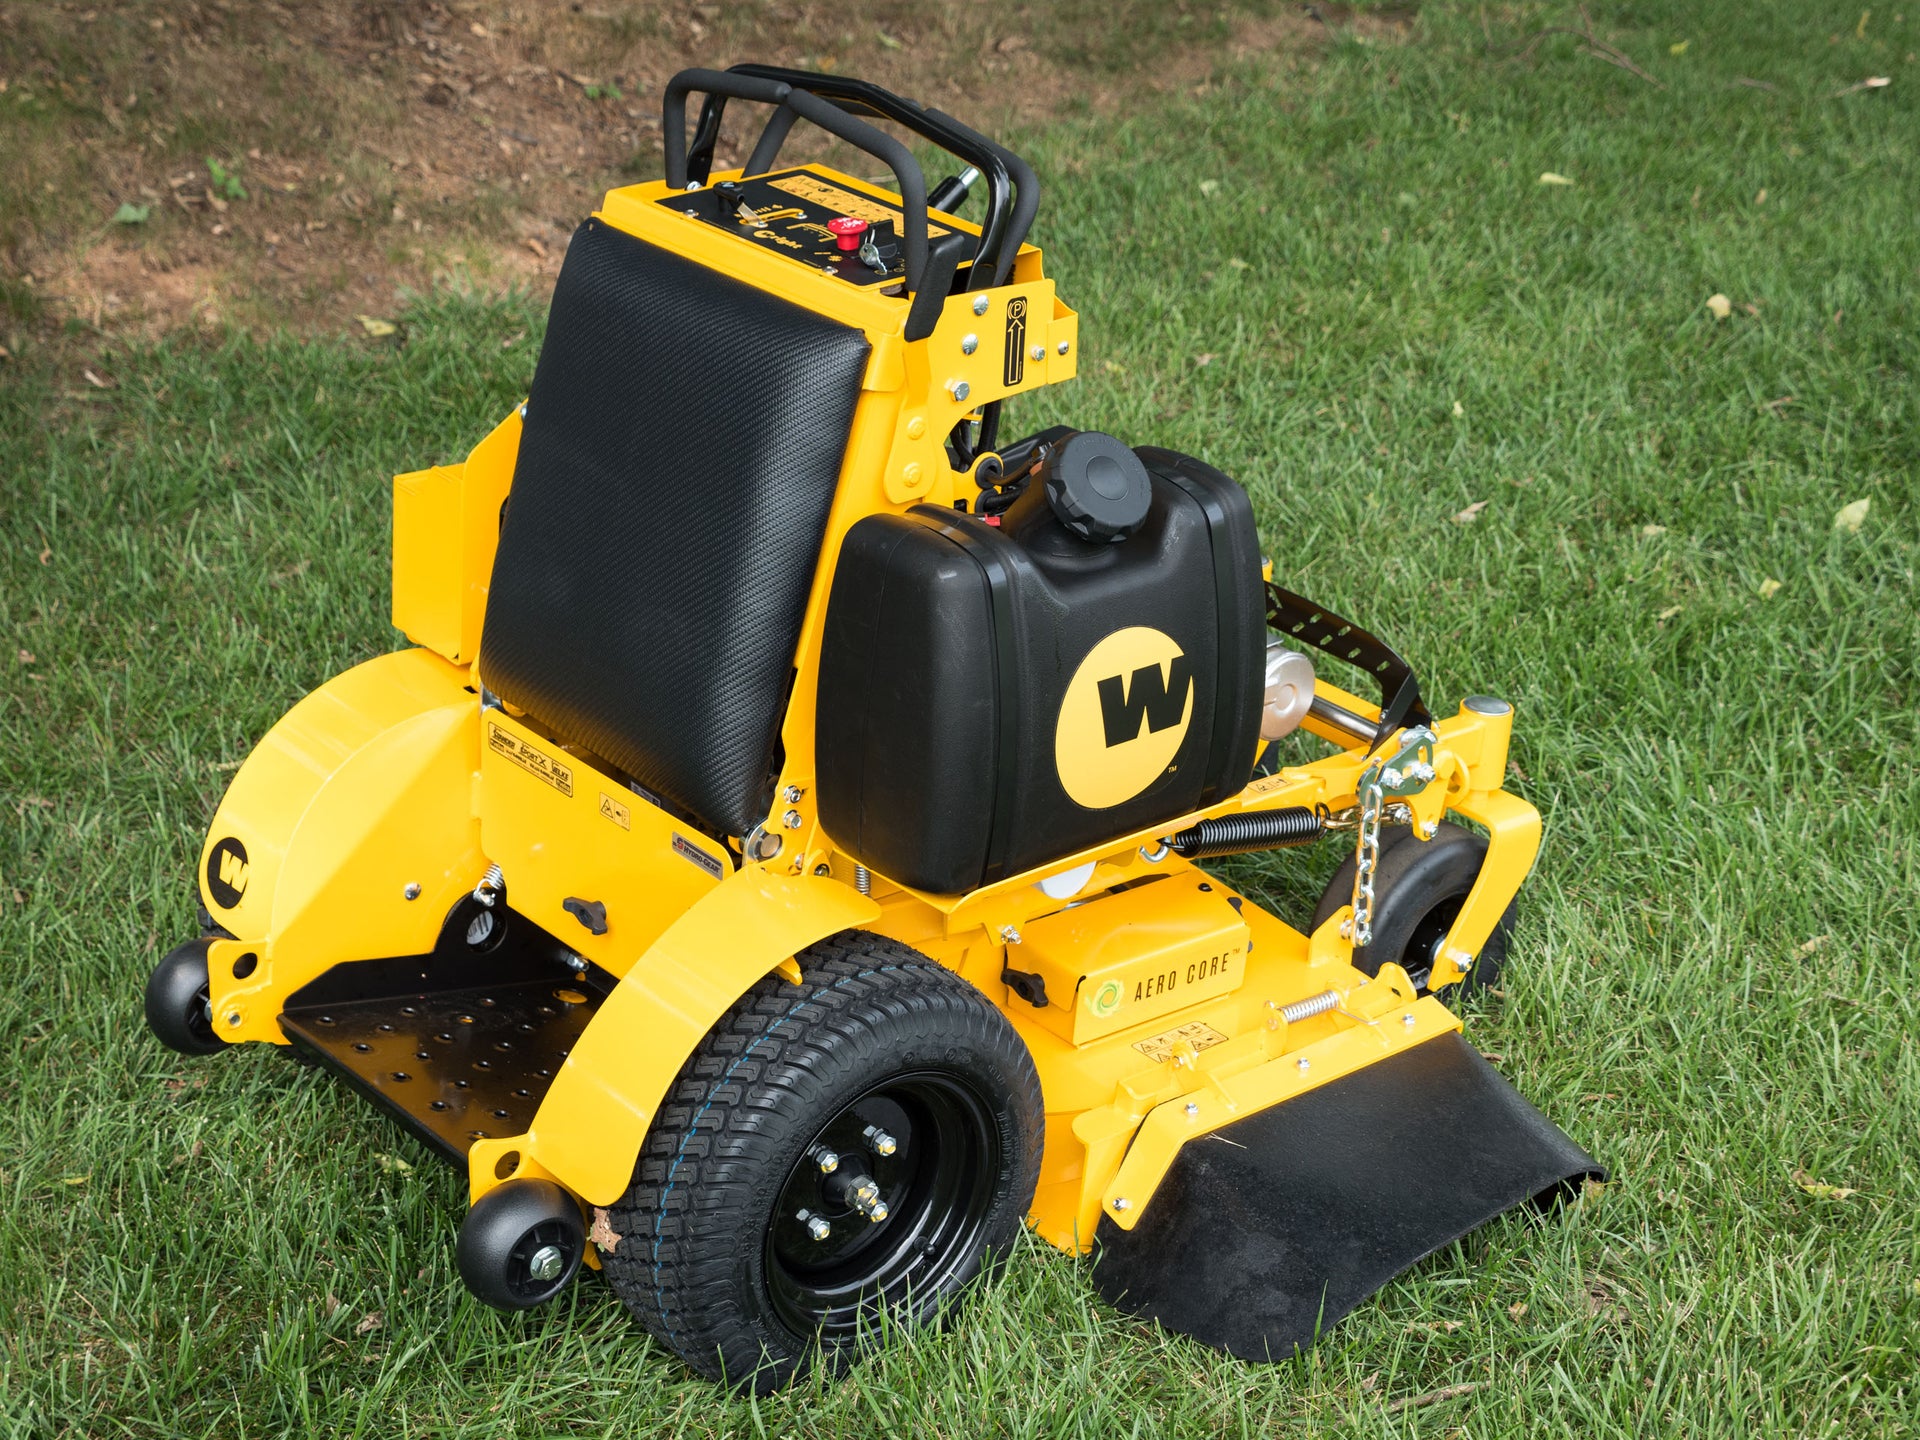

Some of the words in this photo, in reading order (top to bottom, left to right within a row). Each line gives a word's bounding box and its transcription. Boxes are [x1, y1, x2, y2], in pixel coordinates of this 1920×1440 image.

[1013, 303, 1022, 316] P
[1097, 654, 1192, 748] W
[219, 848, 249, 894] W
[1134, 970, 1177, 1002] AERO
[1186, 952, 1230, 985] CORE
